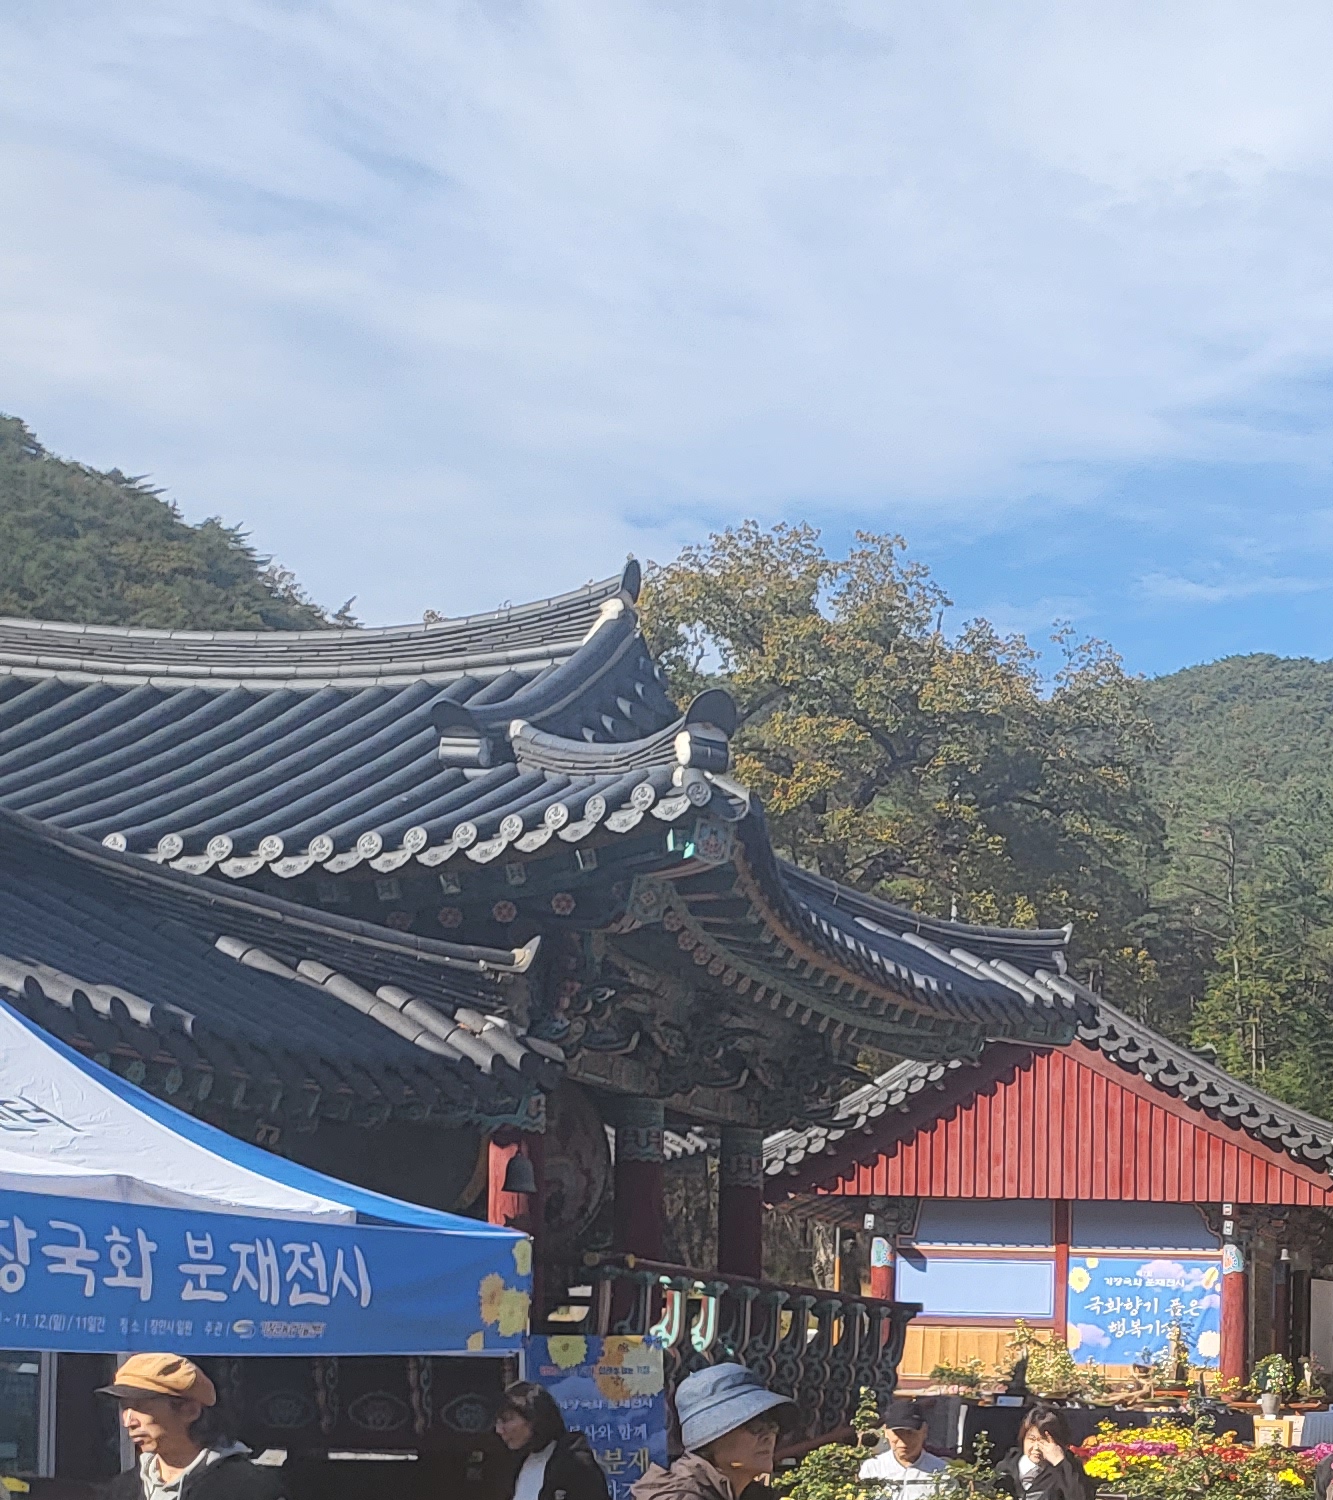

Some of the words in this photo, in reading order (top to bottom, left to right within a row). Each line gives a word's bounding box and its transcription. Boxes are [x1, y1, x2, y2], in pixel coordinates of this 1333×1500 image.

[178, 1231, 372, 1308] 분재전시
[1084, 1295, 1158, 1316] 국화향기
[1165, 1297, 1202, 1317] 품은
[618, 1423, 647, 1440] 함께
[594, 1447, 649, 1475] 분재
